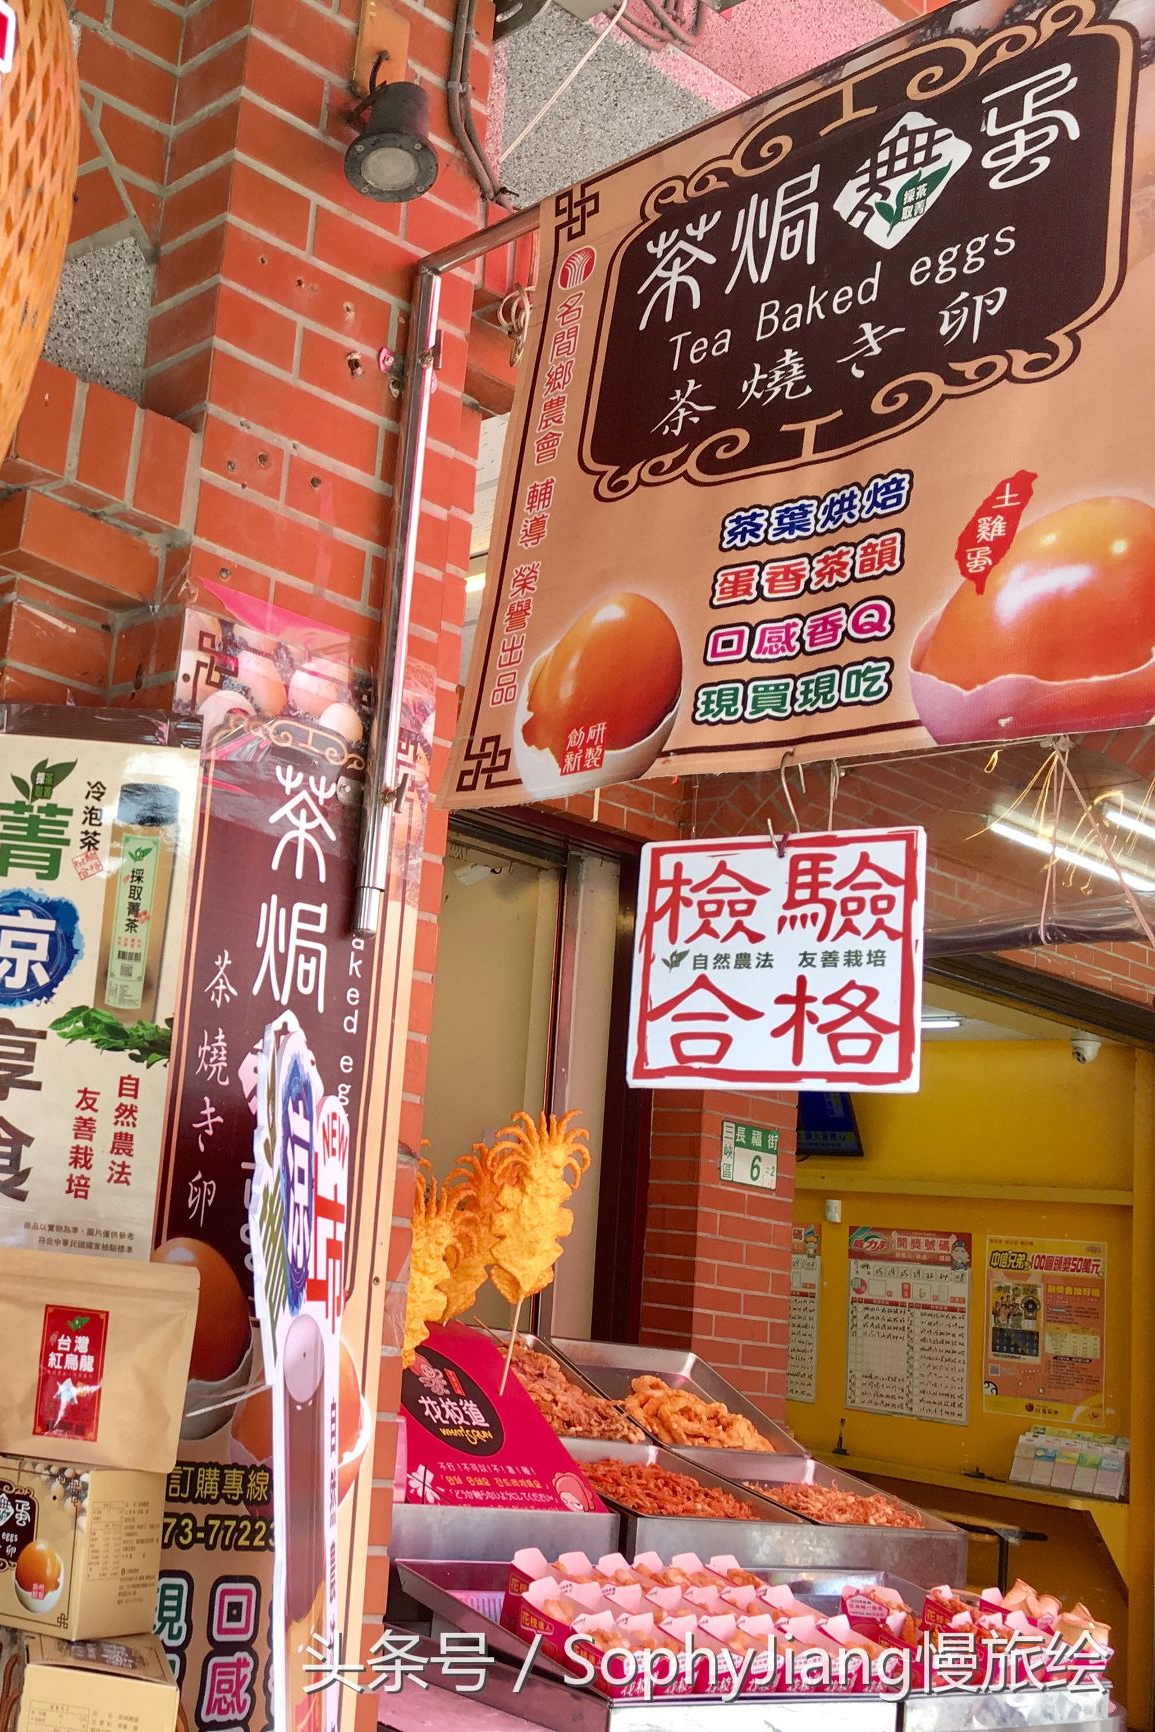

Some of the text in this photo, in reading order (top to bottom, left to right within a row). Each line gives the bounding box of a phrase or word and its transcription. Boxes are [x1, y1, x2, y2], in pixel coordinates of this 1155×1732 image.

[670, 223, 1016, 372] Tea Baked eggs
[489, 289, 586, 709] 名間鄉農會 輔導 榮譽出品
[722, 473, 910, 550] 茶葉烘焙
[965, 483, 1021, 574] 土雞蛋
[713, 532, 902, 606] 蛋香茶韻
[707, 599, 894, 664] 口感香Q
[695, 660, 892, 723] 現買現吃
[79, 781, 107, 852] 冷泡茶
[652, 852, 905, 945] 檢驗
[343, 938, 365, 1034] aked
[693, 949, 887, 970] 自然農法 友善栽培
[647, 974, 900, 1066] 合格
[65, 1087, 100, 1200] 友善栽培
[107, 1074, 140, 1186] 自然農法
[735, 1126, 778, 1151] 長福街
[750, 1155, 762, 1181] 6
[58, 1334, 90, 1353] 台灣
[169, 1466, 270, 1500] 訂購專線
